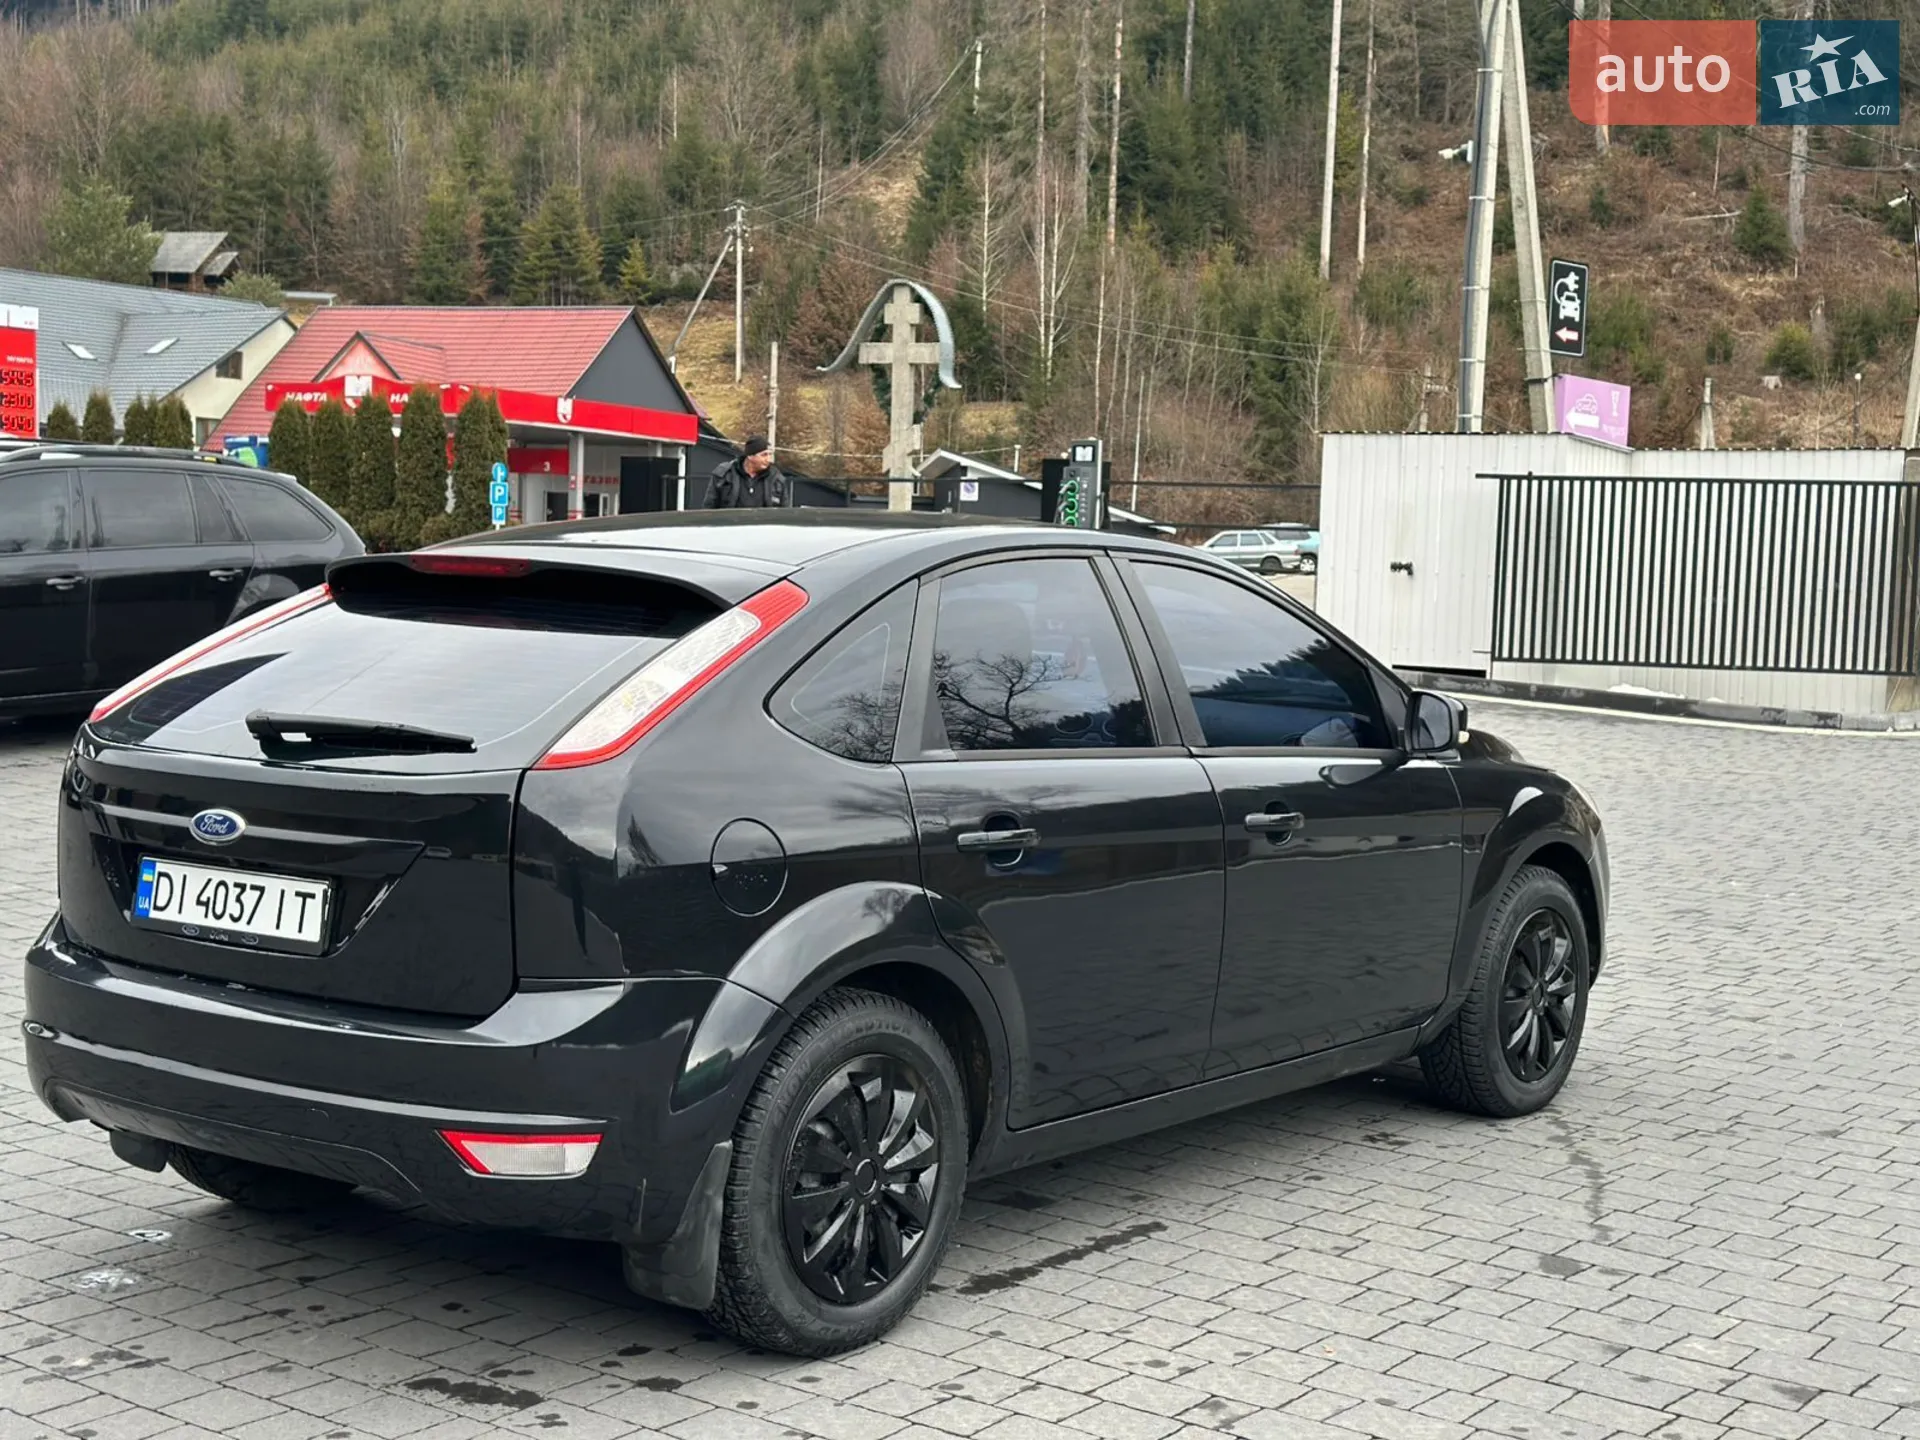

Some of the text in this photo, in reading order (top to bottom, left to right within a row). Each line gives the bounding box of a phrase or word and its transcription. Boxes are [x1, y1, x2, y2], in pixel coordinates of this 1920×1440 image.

[285, 392, 327, 402] НАФТА
[494, 485, 504, 502] P
[201, 815, 229, 834] Ford
[138, 897, 150, 909] UA
[153, 872, 316, 933] DI 4037 IT
